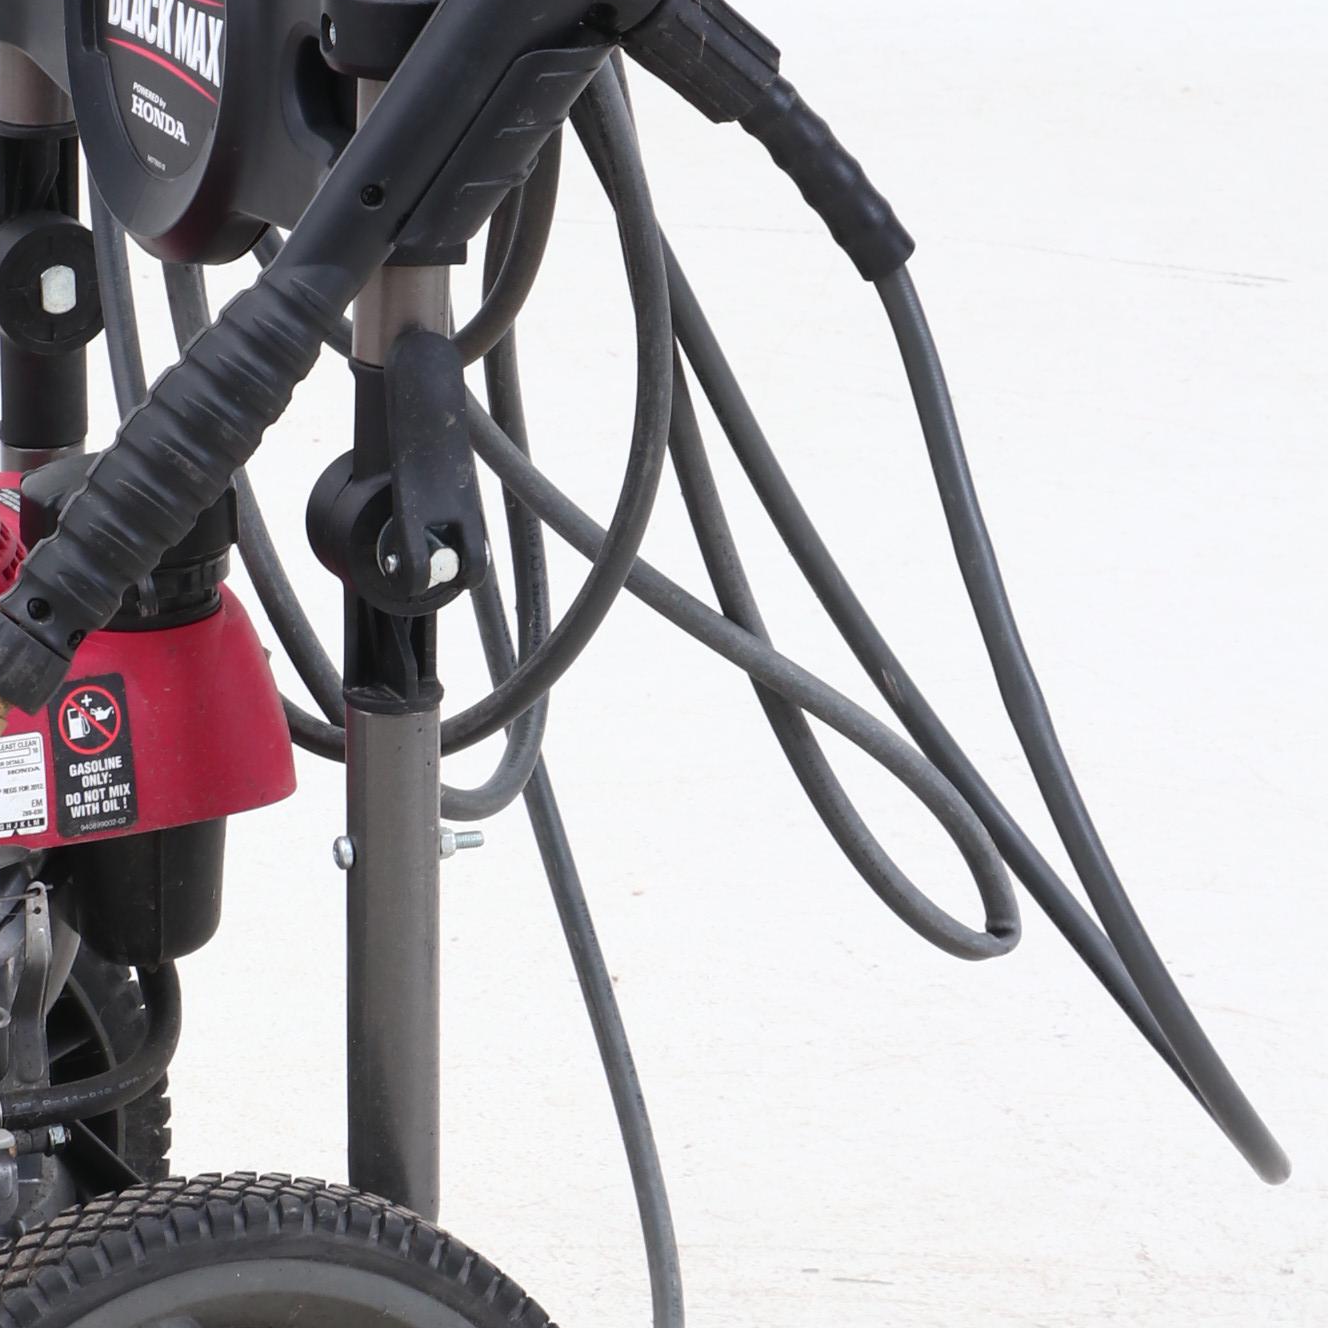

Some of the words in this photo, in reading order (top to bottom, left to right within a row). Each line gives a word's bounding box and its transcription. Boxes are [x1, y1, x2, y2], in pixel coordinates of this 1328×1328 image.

[174, 0, 224, 88] MAX
[132, 81, 160, 107] POWERED
[157, 97, 167, 110] by
[131, 93, 188, 146] HONDA
[17, 740, 37, 748] CLEAN
[68, 755, 122, 777] GASOLINE
[65, 791, 81, 806] DO
[83, 787, 106, 803] NOT
[108, 782, 131, 798] MIX
[70, 801, 100, 818] WITH
[102, 798, 120, 813] OIL
[122, 796, 127, 809] !
